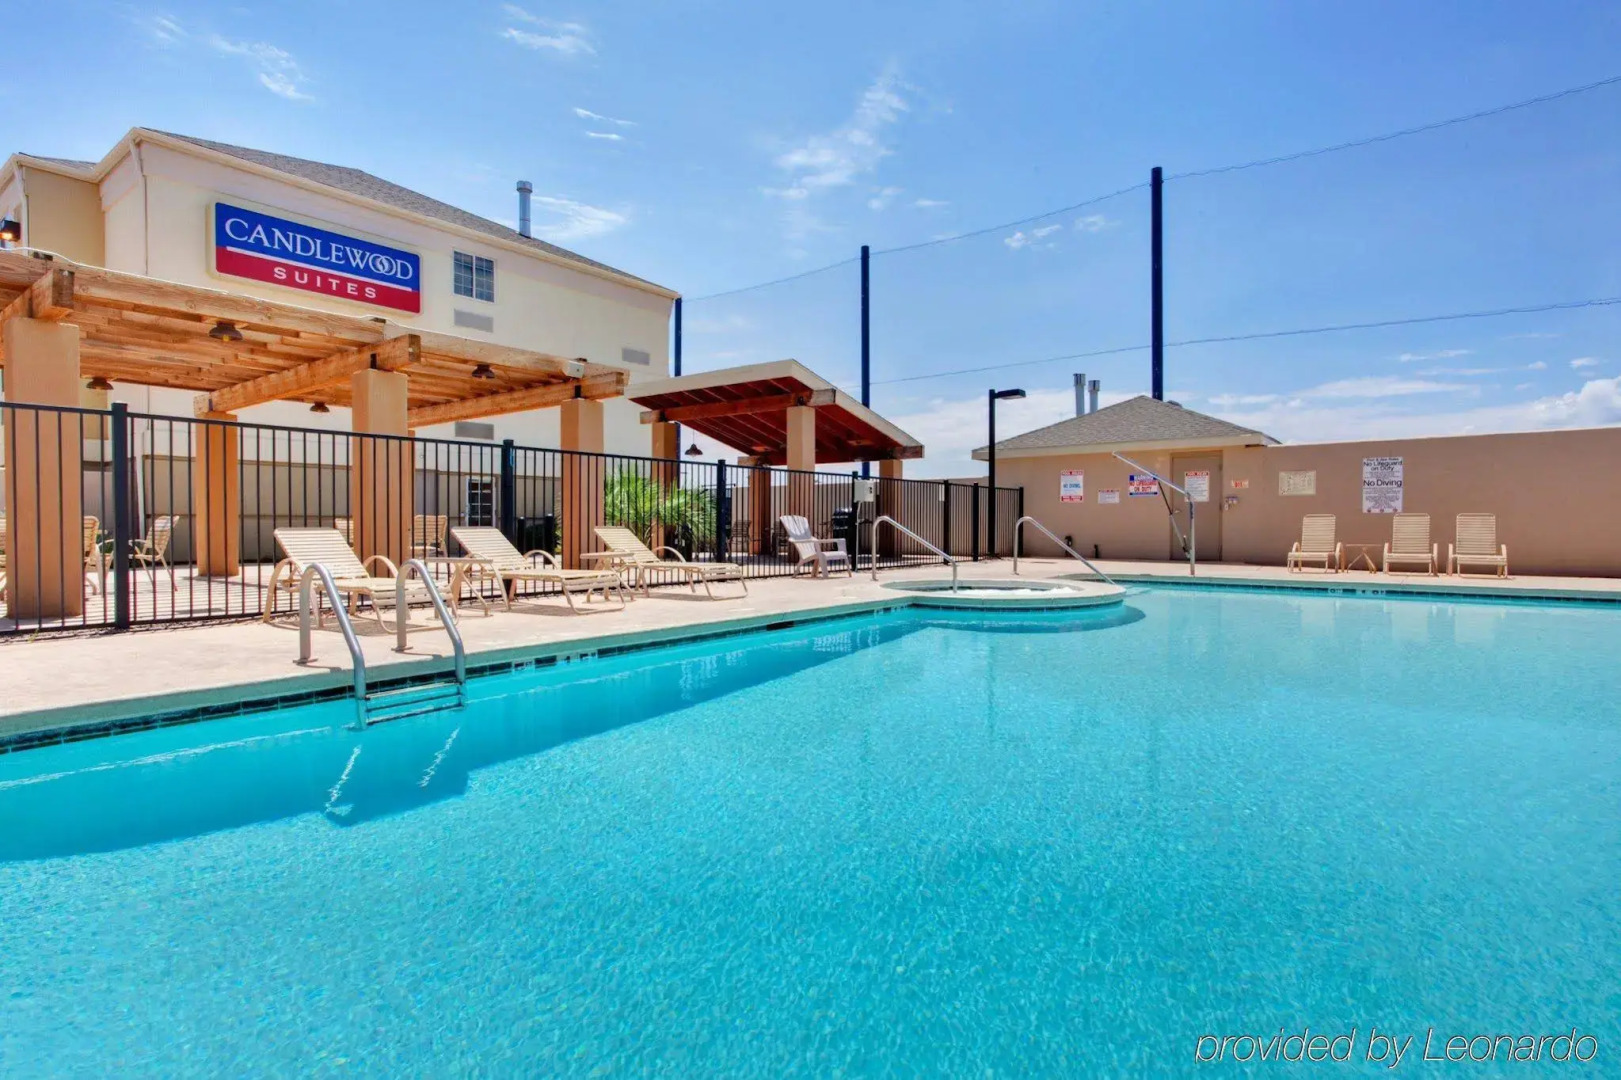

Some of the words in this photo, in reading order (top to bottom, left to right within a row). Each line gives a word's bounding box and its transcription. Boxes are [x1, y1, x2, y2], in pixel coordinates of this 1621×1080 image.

[225, 218, 413, 280] CANDLEWOOD
[273, 266, 377, 299] SUITES
[1374, 460, 1403, 468] Lifeguard
[1376, 479, 1403, 488] Diving
